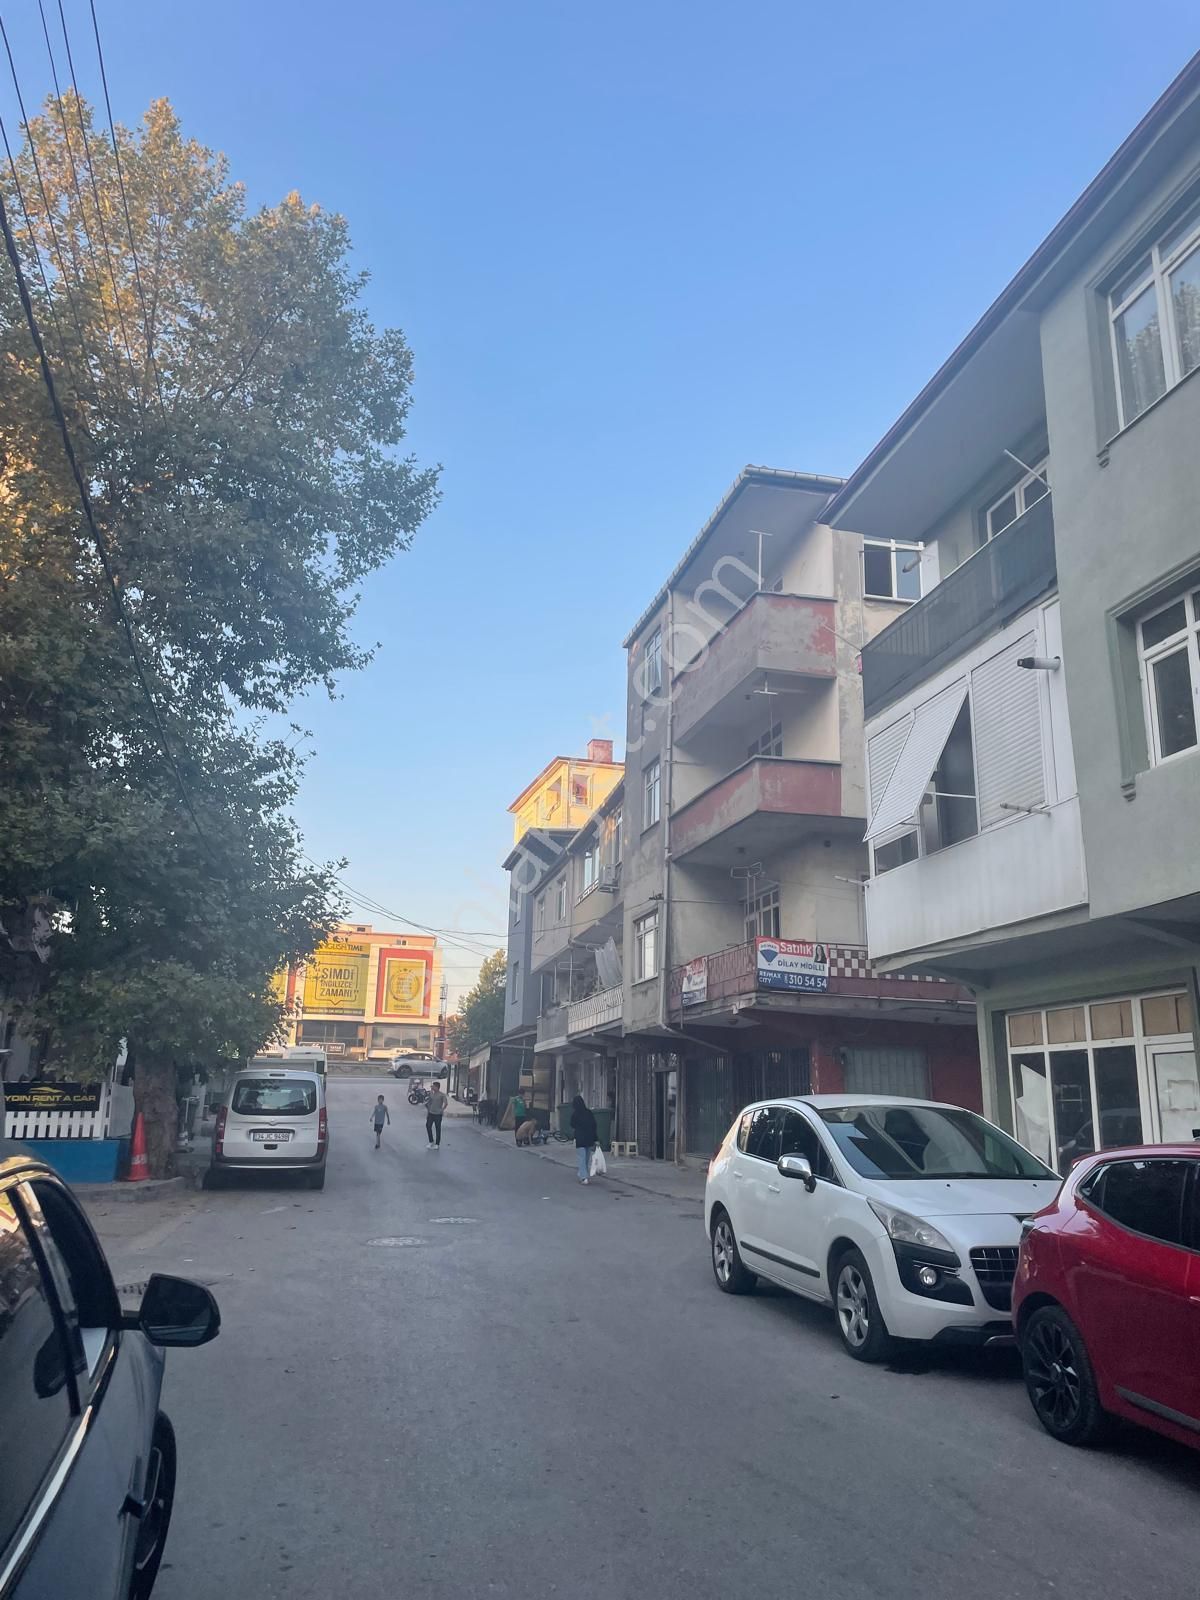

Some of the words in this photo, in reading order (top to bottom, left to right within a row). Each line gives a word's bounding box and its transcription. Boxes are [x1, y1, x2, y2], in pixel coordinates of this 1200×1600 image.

[347, 944, 363, 952] TIME
[778, 959, 799, 968] DİLAY
[759, 971, 781, 979] RE/MAX
[789, 974, 803, 985] 310
[805, 977, 815, 986] 54
[817, 978, 828, 988] 54
